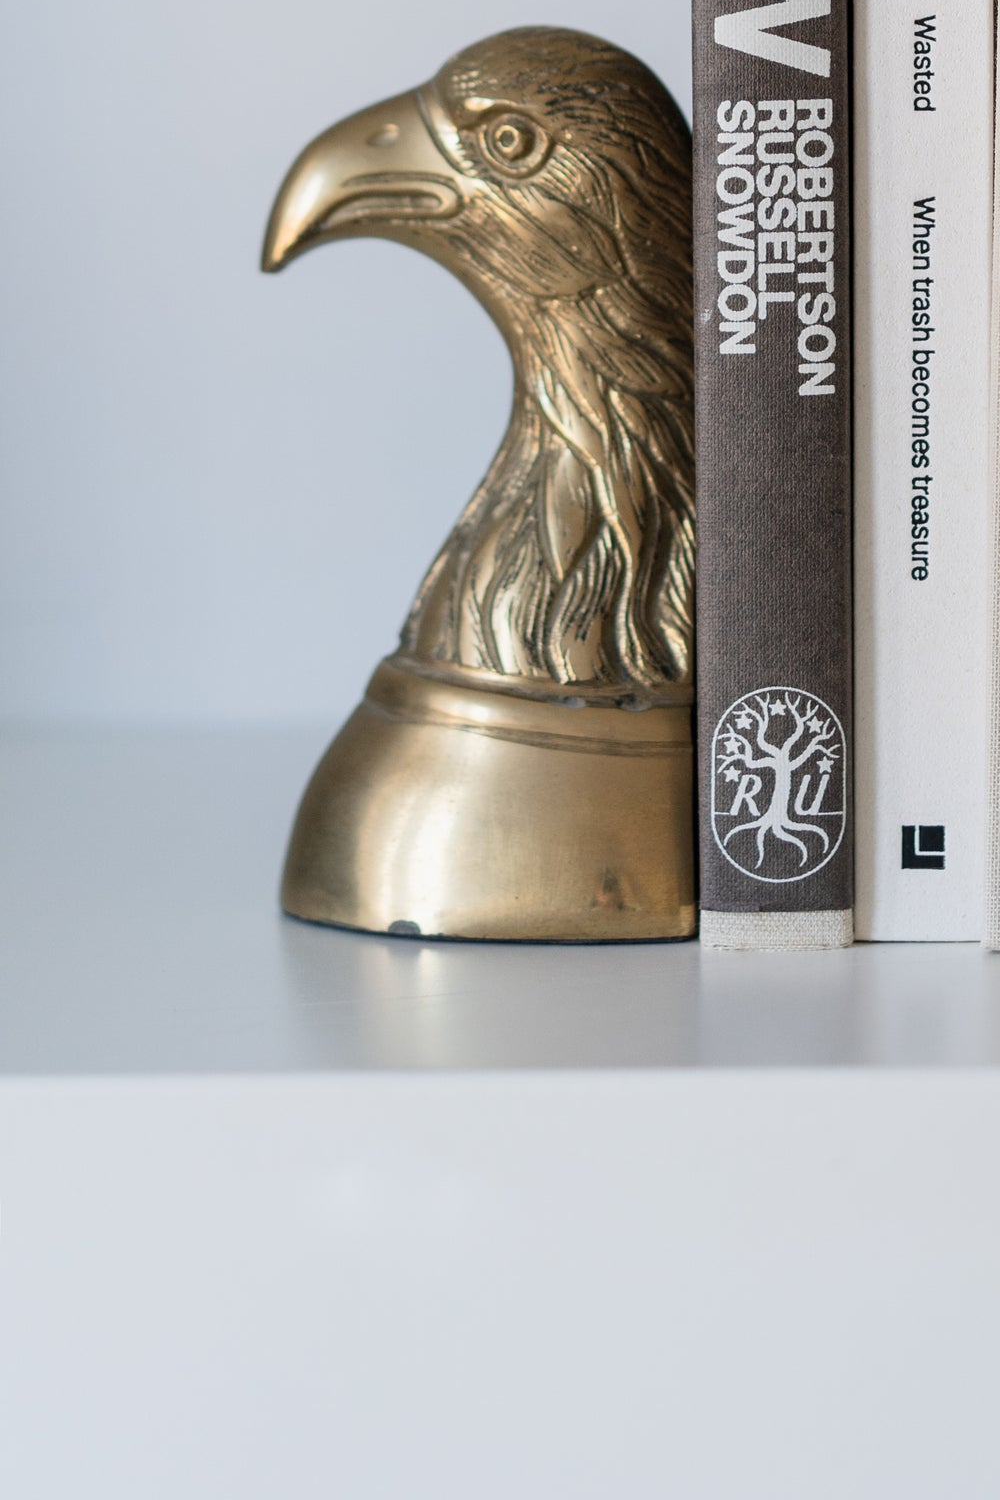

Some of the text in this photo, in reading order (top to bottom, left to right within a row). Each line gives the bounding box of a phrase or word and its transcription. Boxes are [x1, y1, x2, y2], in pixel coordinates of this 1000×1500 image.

[913, 15, 936, 112] Wasted
[716, 100, 757, 355] SNOWDON
[756, 99, 797, 320] RUSSELL
[796, 98, 836, 396] ROBERTSON
[911, 196, 936, 581] When trash becomes treasure
